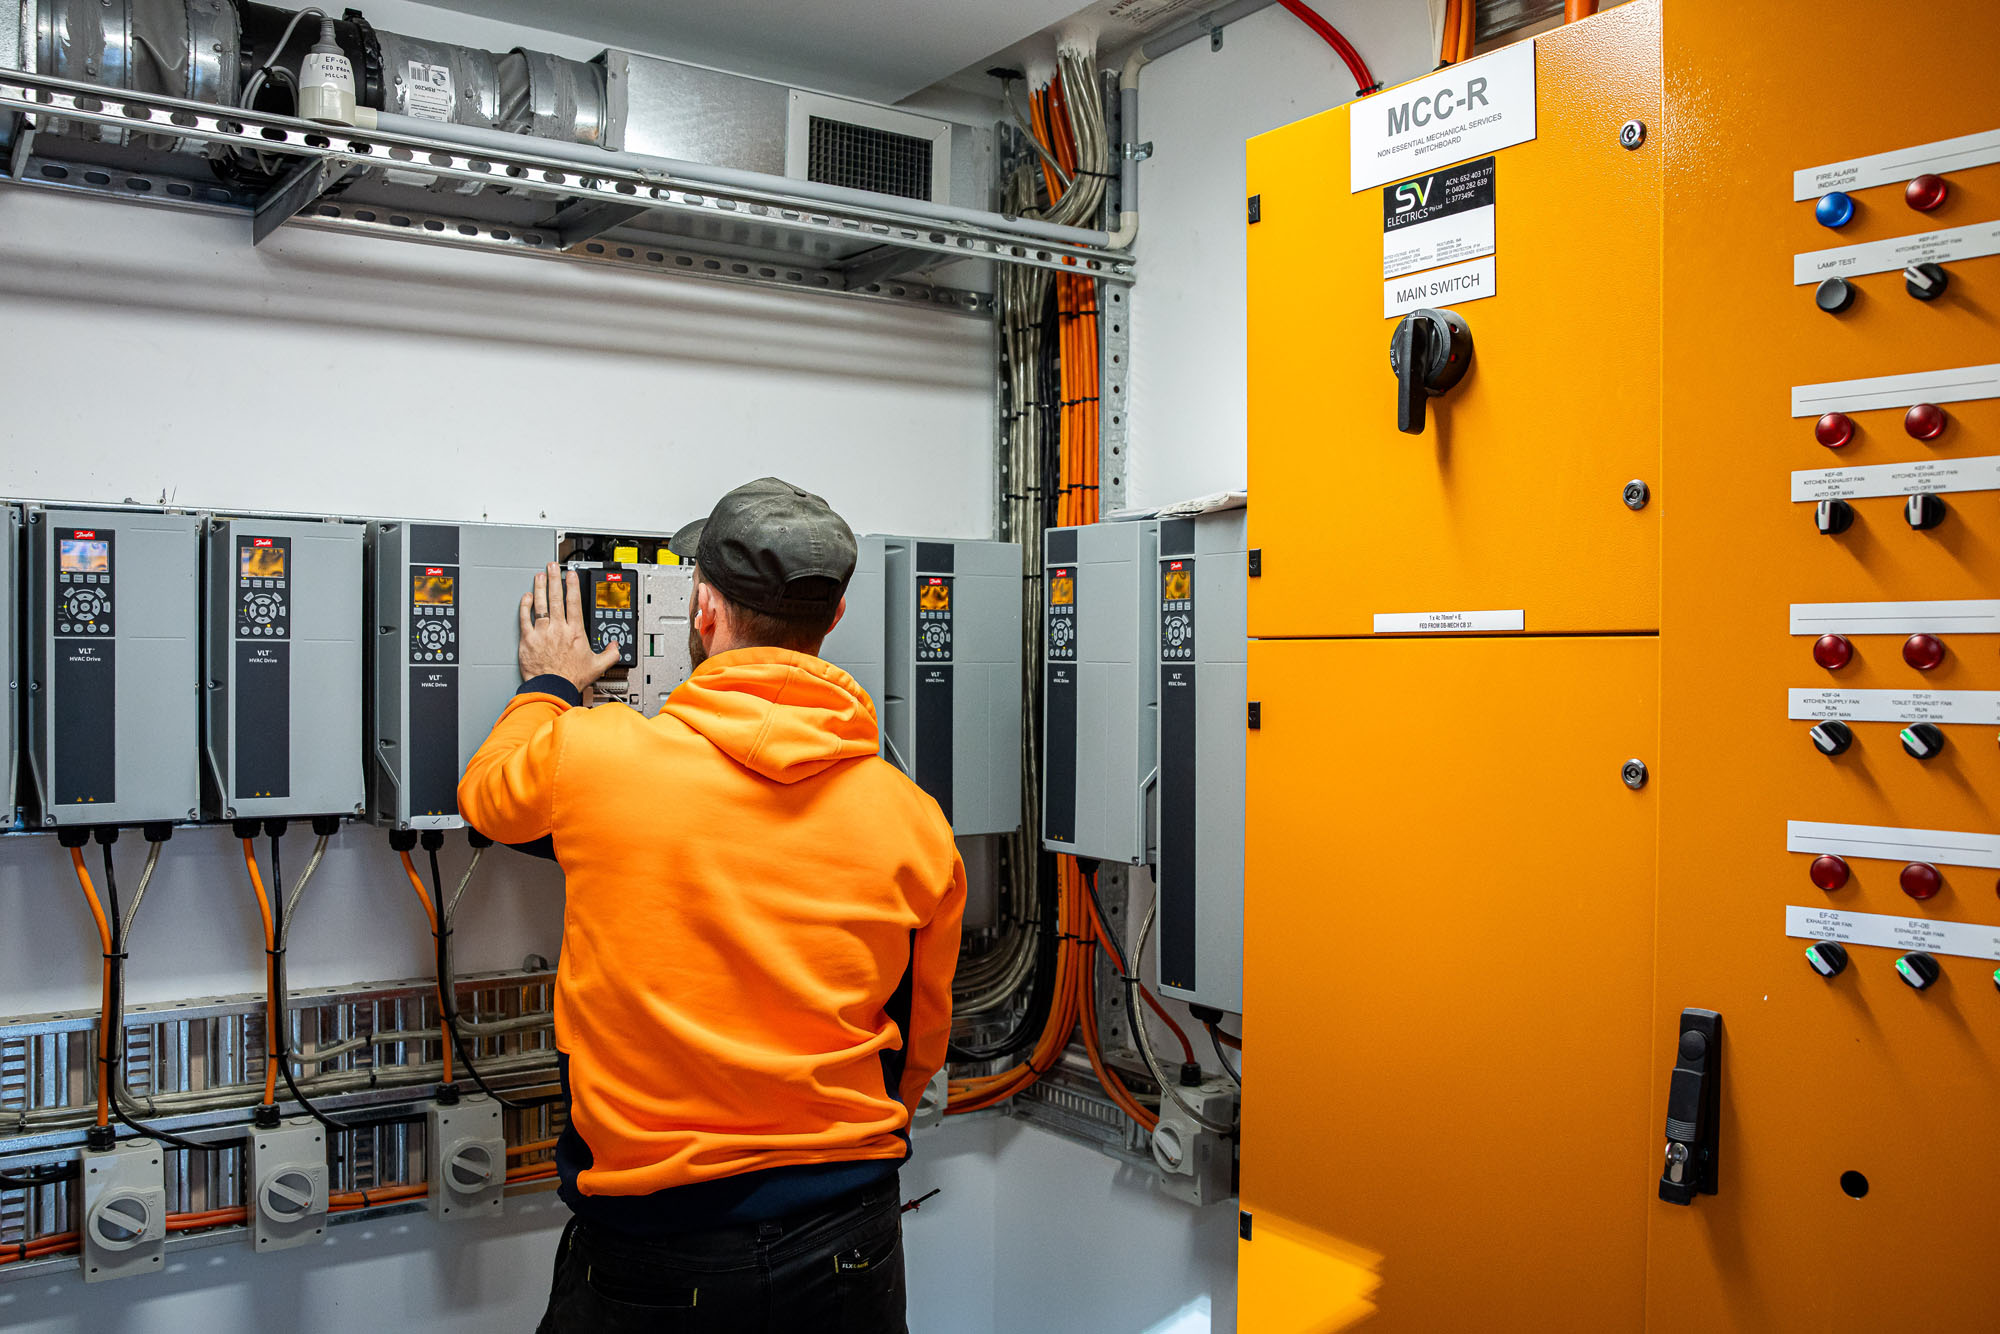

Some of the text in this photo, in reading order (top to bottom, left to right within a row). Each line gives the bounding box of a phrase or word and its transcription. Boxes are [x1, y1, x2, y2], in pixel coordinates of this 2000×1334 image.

[1388, 77, 1489, 137] MCC-R
[1377, 112, 1502, 158] NON ESSENTIAL MECHANICAL SERVICES
[1414, 136, 1461, 156] SWITCHBOARD
[1445, 167, 1493, 186] ACN: 652 403 177
[1816, 168, 1858, 181] FIRE ALARM
[1817, 176, 1856, 189] INDICATOR
[1395, 176, 1434, 214] SV
[1451, 184, 1465, 193] 0400
[1466, 181, 1476, 189] 282
[1477, 178, 1487, 186] 639
[1451, 190, 1474, 203] 377349C
[1387, 208, 1429, 228] ELECTRICS
[1817, 258, 1856, 270] LAMP TEST
[1397, 273, 1480, 303] MAIN SWITCH
[1819, 912, 1839, 920] EF-02
